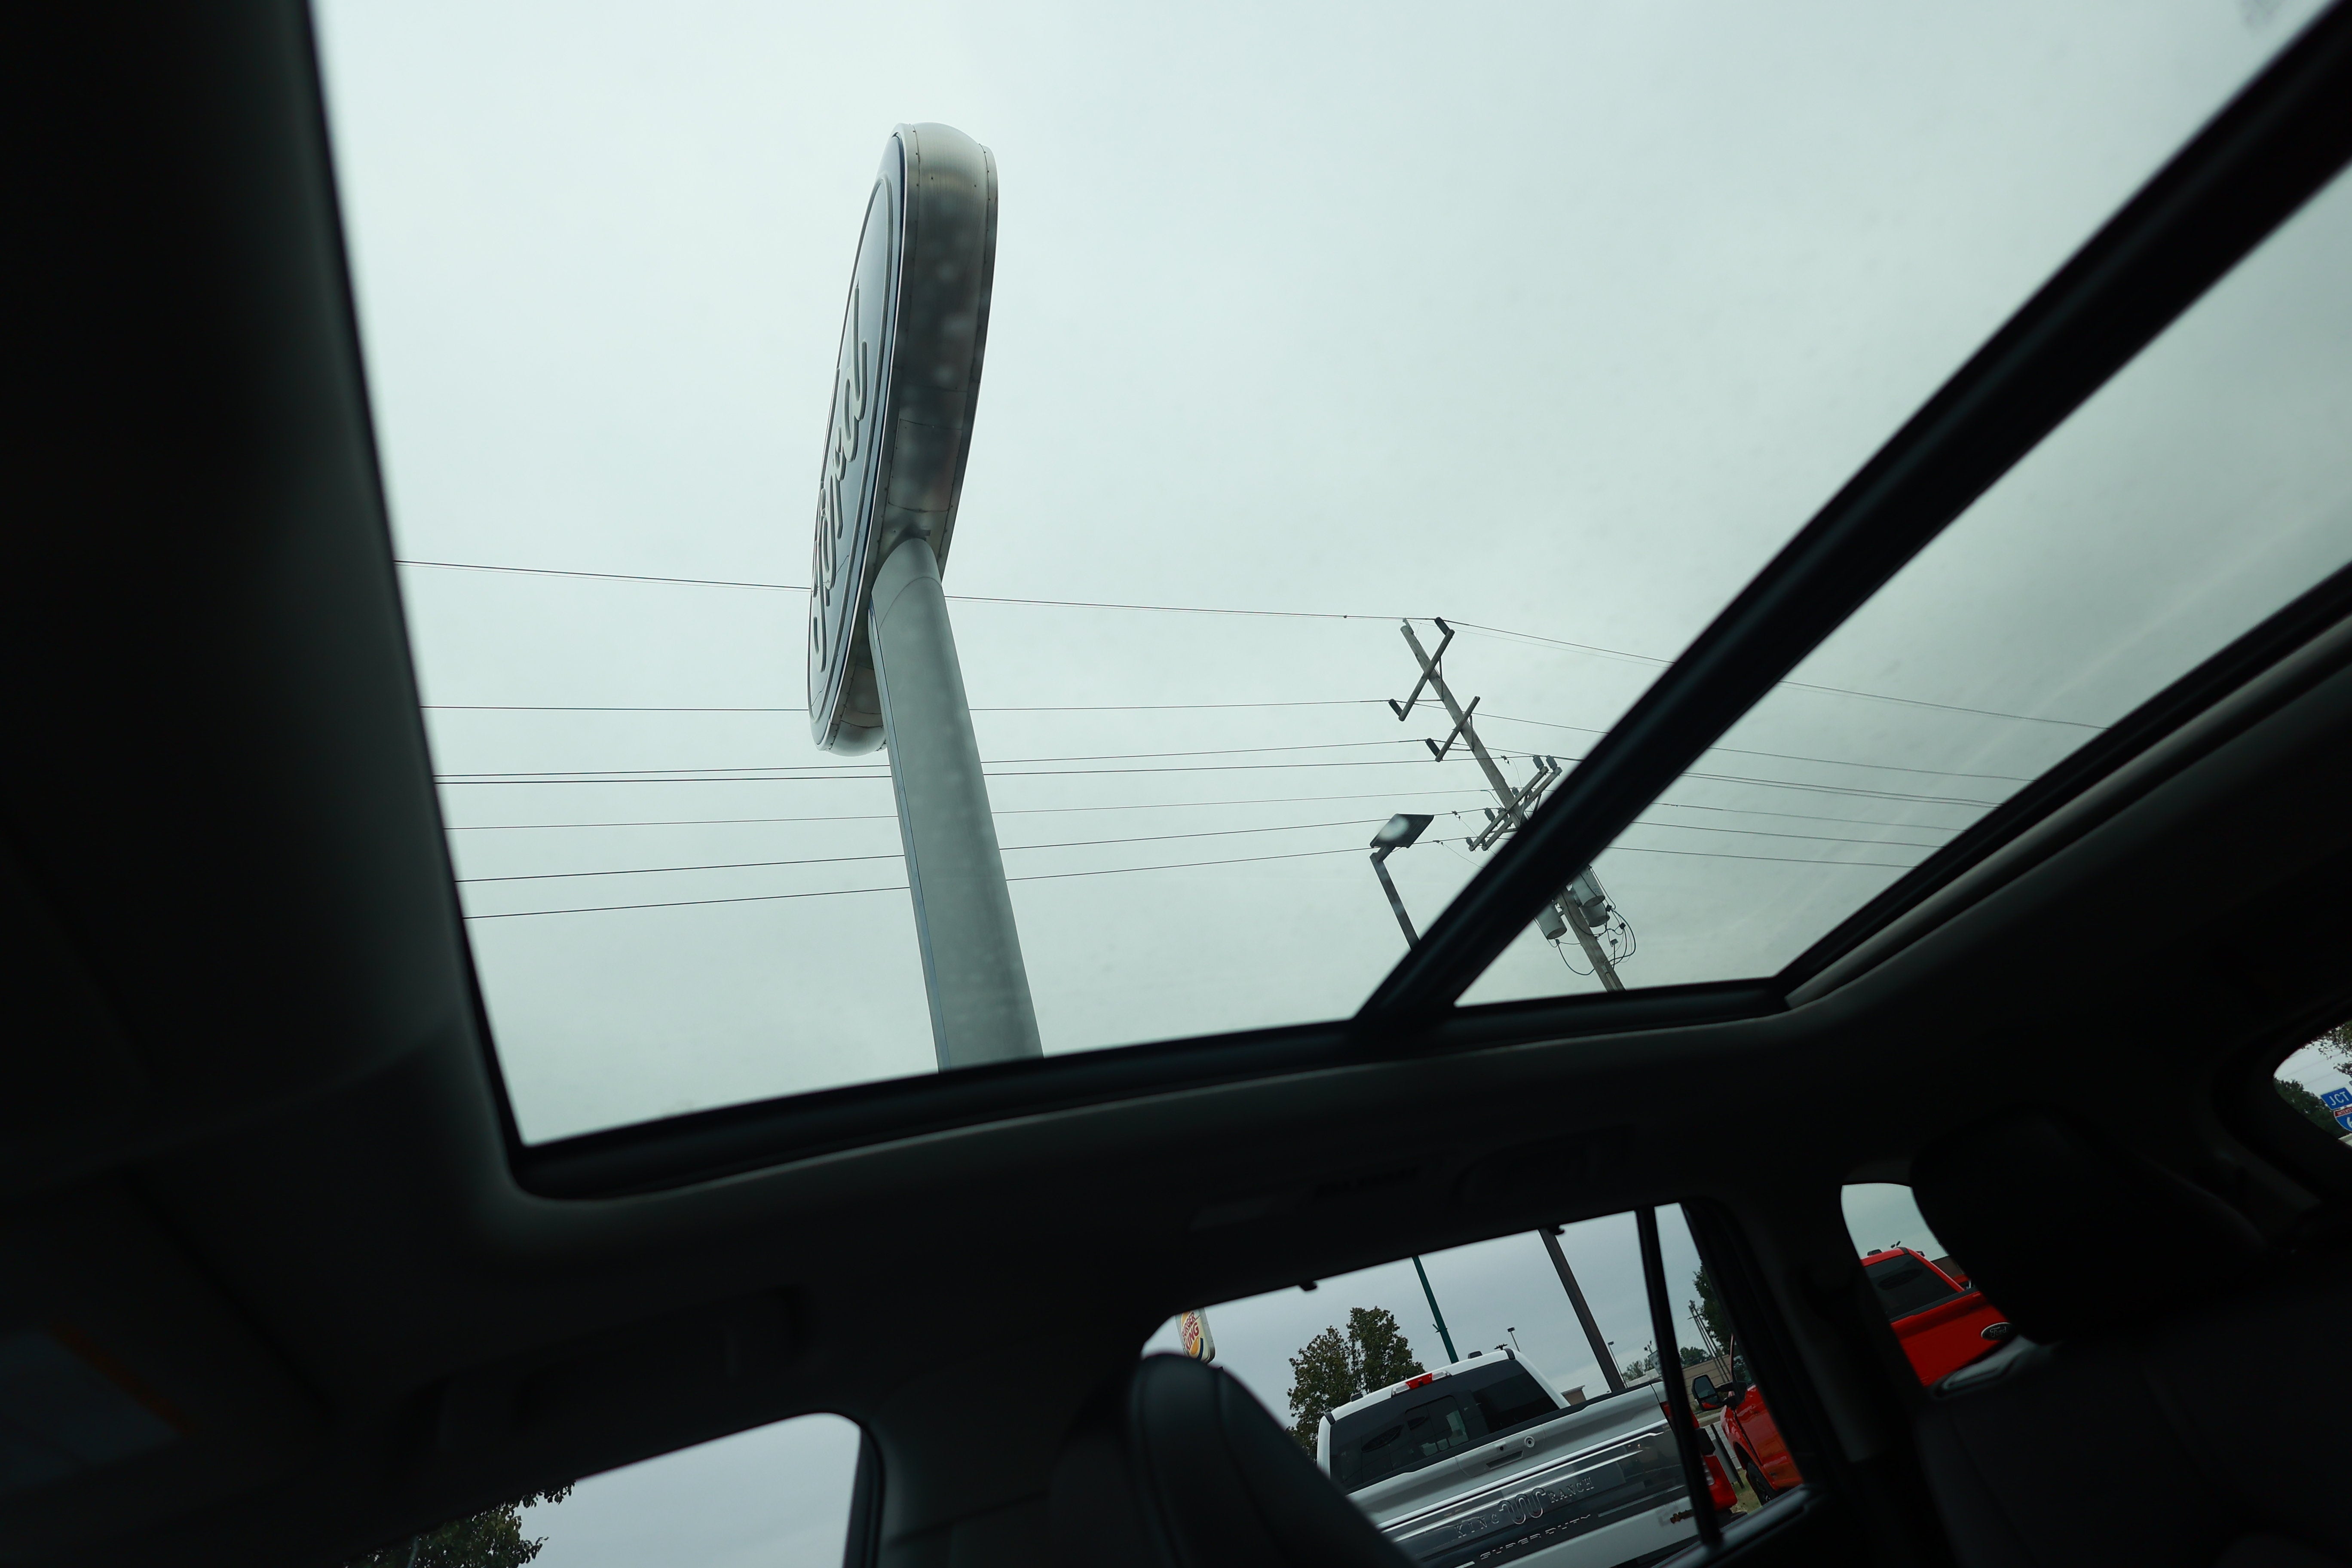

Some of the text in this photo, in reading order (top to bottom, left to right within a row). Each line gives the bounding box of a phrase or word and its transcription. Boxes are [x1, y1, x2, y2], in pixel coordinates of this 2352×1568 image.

[813, 285, 867, 673] Ford
[2329, 1091, 2349, 1106] JCT
[1186, 1322, 1199, 1351] KING
[1454, 1477, 1594, 1539] KING RANCH
[1480, 1514, 1590, 1560] SUPER DUTY
